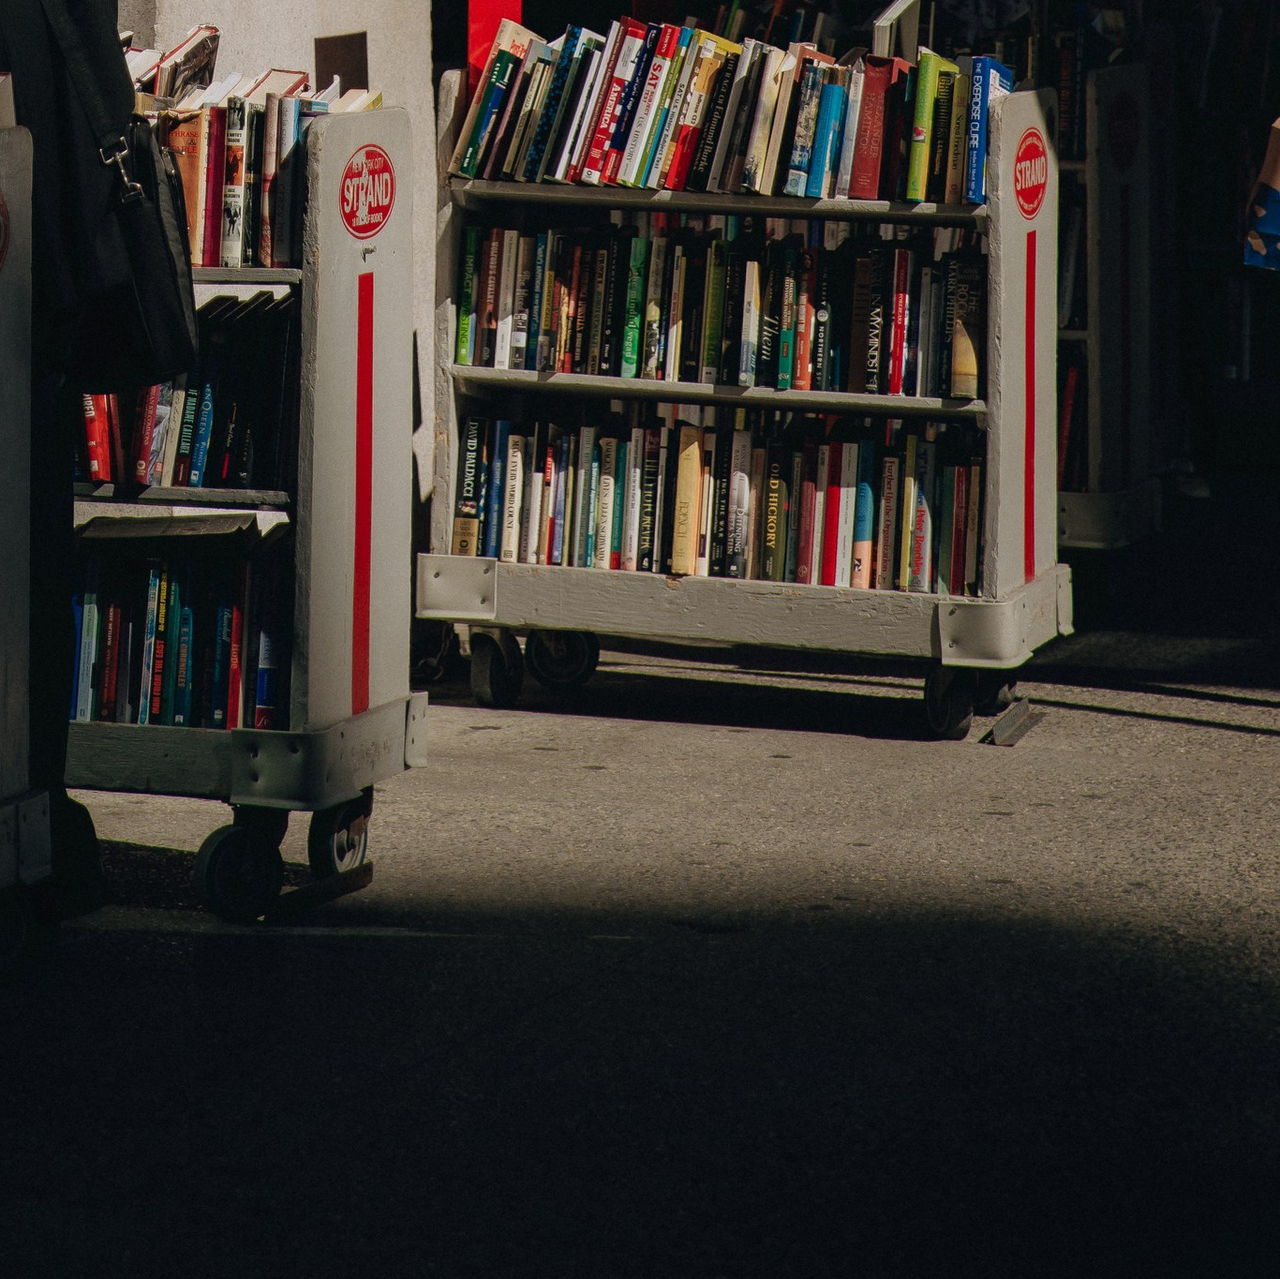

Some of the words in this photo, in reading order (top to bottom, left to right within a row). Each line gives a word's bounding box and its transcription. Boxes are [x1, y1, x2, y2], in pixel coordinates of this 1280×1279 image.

[645, 62, 663, 89] SAT
[719, 71, 731, 92] RAGE
[641, 88, 650, 103] TEST
[642, 90, 655, 116] SUBJECT
[676, 82, 685, 97] SAT
[970, 75, 982, 120] EXERCISE
[282, 107, 288, 115] de
[599, 82, 621, 130] AMERICA
[635, 116, 645, 129] U.S.
[663, 110, 675, 132] History
[705, 104, 723, 144] Edmund
[857, 90, 875, 155] HAMILTON
[868, 90, 885, 159] ALEXANDER
[954, 113, 962, 135] Sonya
[624, 129, 641, 163] HISTORY
[657, 132, 669, 155] Subject
[968, 122, 979, 148] CURE
[653, 156, 661, 169] Test
[697, 144, 712, 173] Burke
[1016, 156, 1046, 191] STRAND
[275, 182, 285, 219] crazy
[344, 172, 391, 214] STRAND
[275, 222, 284, 244] hot
[488, 241, 498, 275] WOLFORD'S
[463, 254, 474, 293] IMPACT
[631, 271, 639, 286] the
[946, 258, 958, 295] MARK
[486, 275, 496, 303] CAVALRY
[515, 288, 529, 310] Hired
[955, 283, 968, 317] ROCK
[967, 289, 981, 313] THE
[513, 312, 527, 328] Girl
[627, 289, 638, 328] mindful
[869, 307, 881, 329] MY
[944, 295, 956, 343] PHILLIPS
[622, 330, 633, 357] vegan
[760, 314, 779, 361] Them
[816, 325, 825, 368] NORTHERN
[147, 385, 156, 411] BRIAN
[183, 396, 196, 423] MADAME
[142, 411, 153, 445] KILCOMMONS
[197, 399, 212, 435] QUEEN
[178, 423, 192, 454] CAILLAUX
[466, 420, 479, 449] DAVID
[196, 440, 205, 466] PATRICIA
[511, 439, 519, 458] MAKE
[462, 450, 476, 497] BALDACCI
[509, 460, 518, 481] EVERY
[769, 462, 779, 488] OLD
[885, 460, 895, 491] Further
[507, 483, 516, 504] WORD
[602, 477, 610, 497] LIVES
[882, 492, 893, 503] Up
[916, 465, 927, 505] Clearance
[505, 505, 514, 530] COUNT
[600, 501, 608, 524] ELLEN
[676, 500, 689, 538] FRENCH
[765, 492, 778, 548] HICKORY
[884, 504, 892, 518] the
[915, 507, 925, 532] Peter
[639, 503, 653, 549] FOREVER
[733, 508, 744, 552] DEFENDING
[726, 533, 734, 555] STEIN
[879, 519, 892, 572] Organization
[911, 533, 924, 575] Benchley
[154, 638, 164, 658] EAST
[229, 643, 238, 669] Hope
[153, 658, 162, 672] THE
[176, 643, 188, 687] CHRONICLES
[152, 672, 161, 695] FROM
[151, 696, 160, 714] MAN
